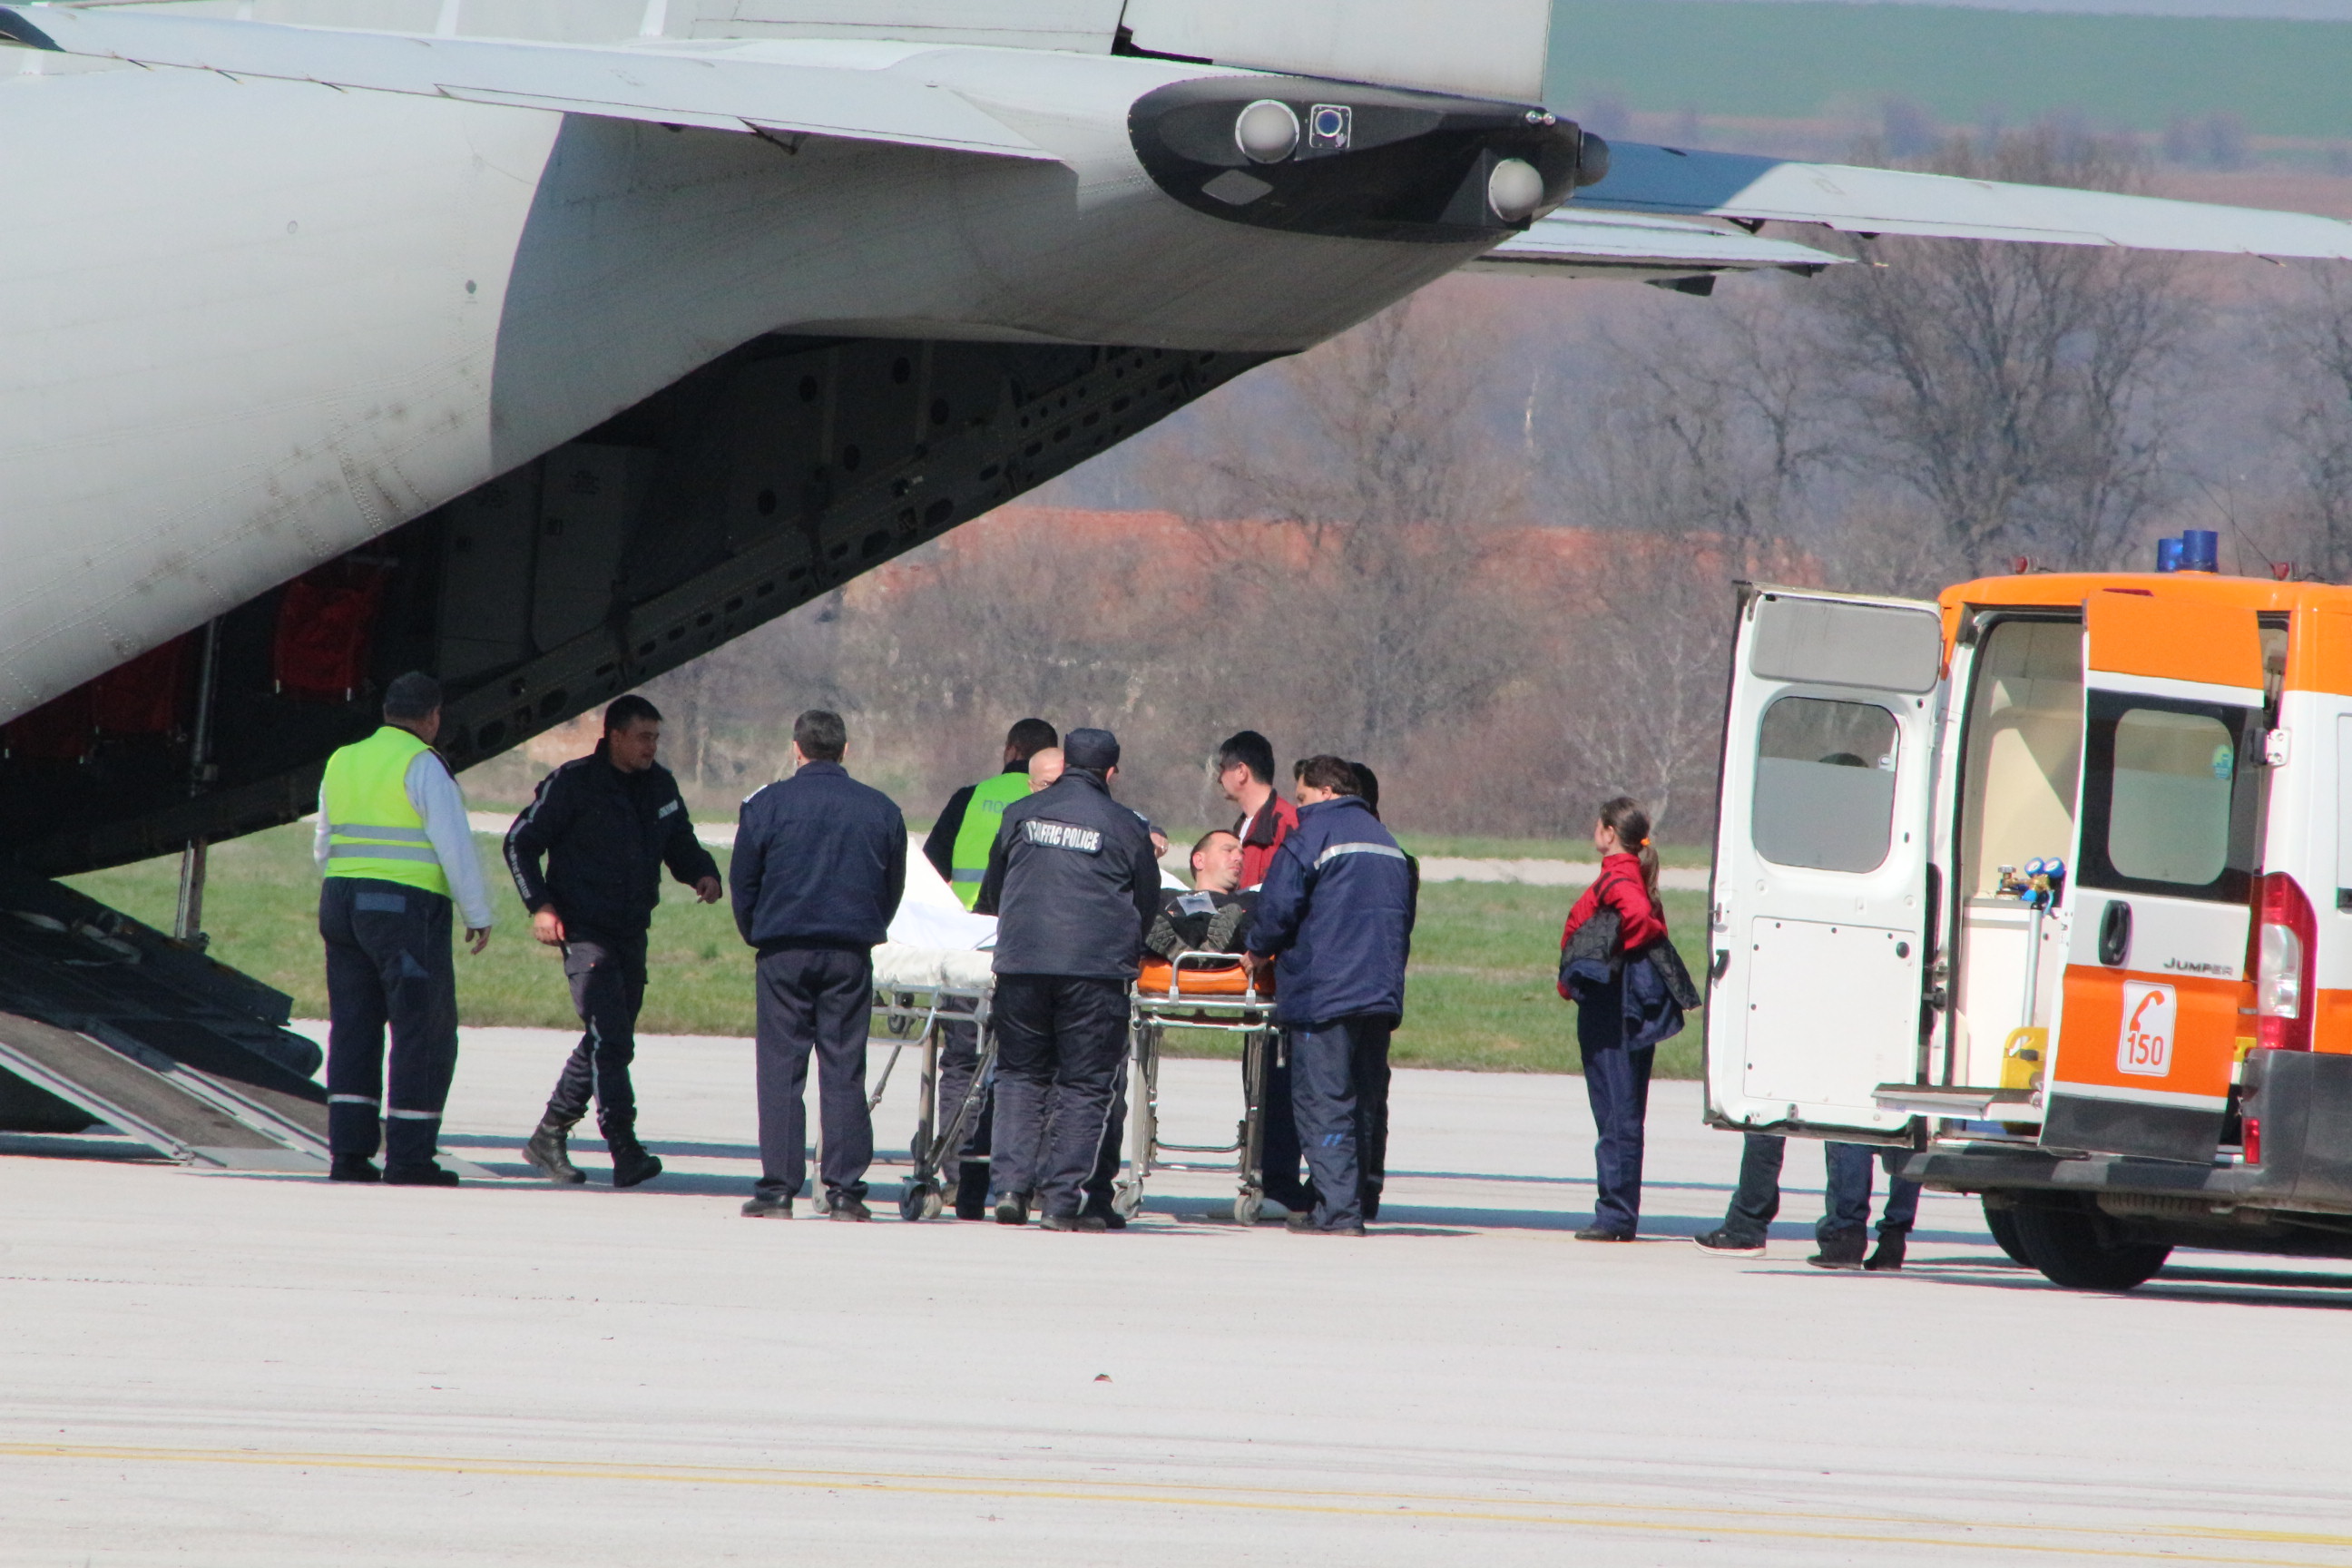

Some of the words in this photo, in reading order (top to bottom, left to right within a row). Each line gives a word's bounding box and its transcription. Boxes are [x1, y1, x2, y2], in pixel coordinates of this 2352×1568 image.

[982, 799, 1011, 814] ПО
[1062, 827, 1101, 851] POLICE
[2127, 1033, 2164, 1065] 150
